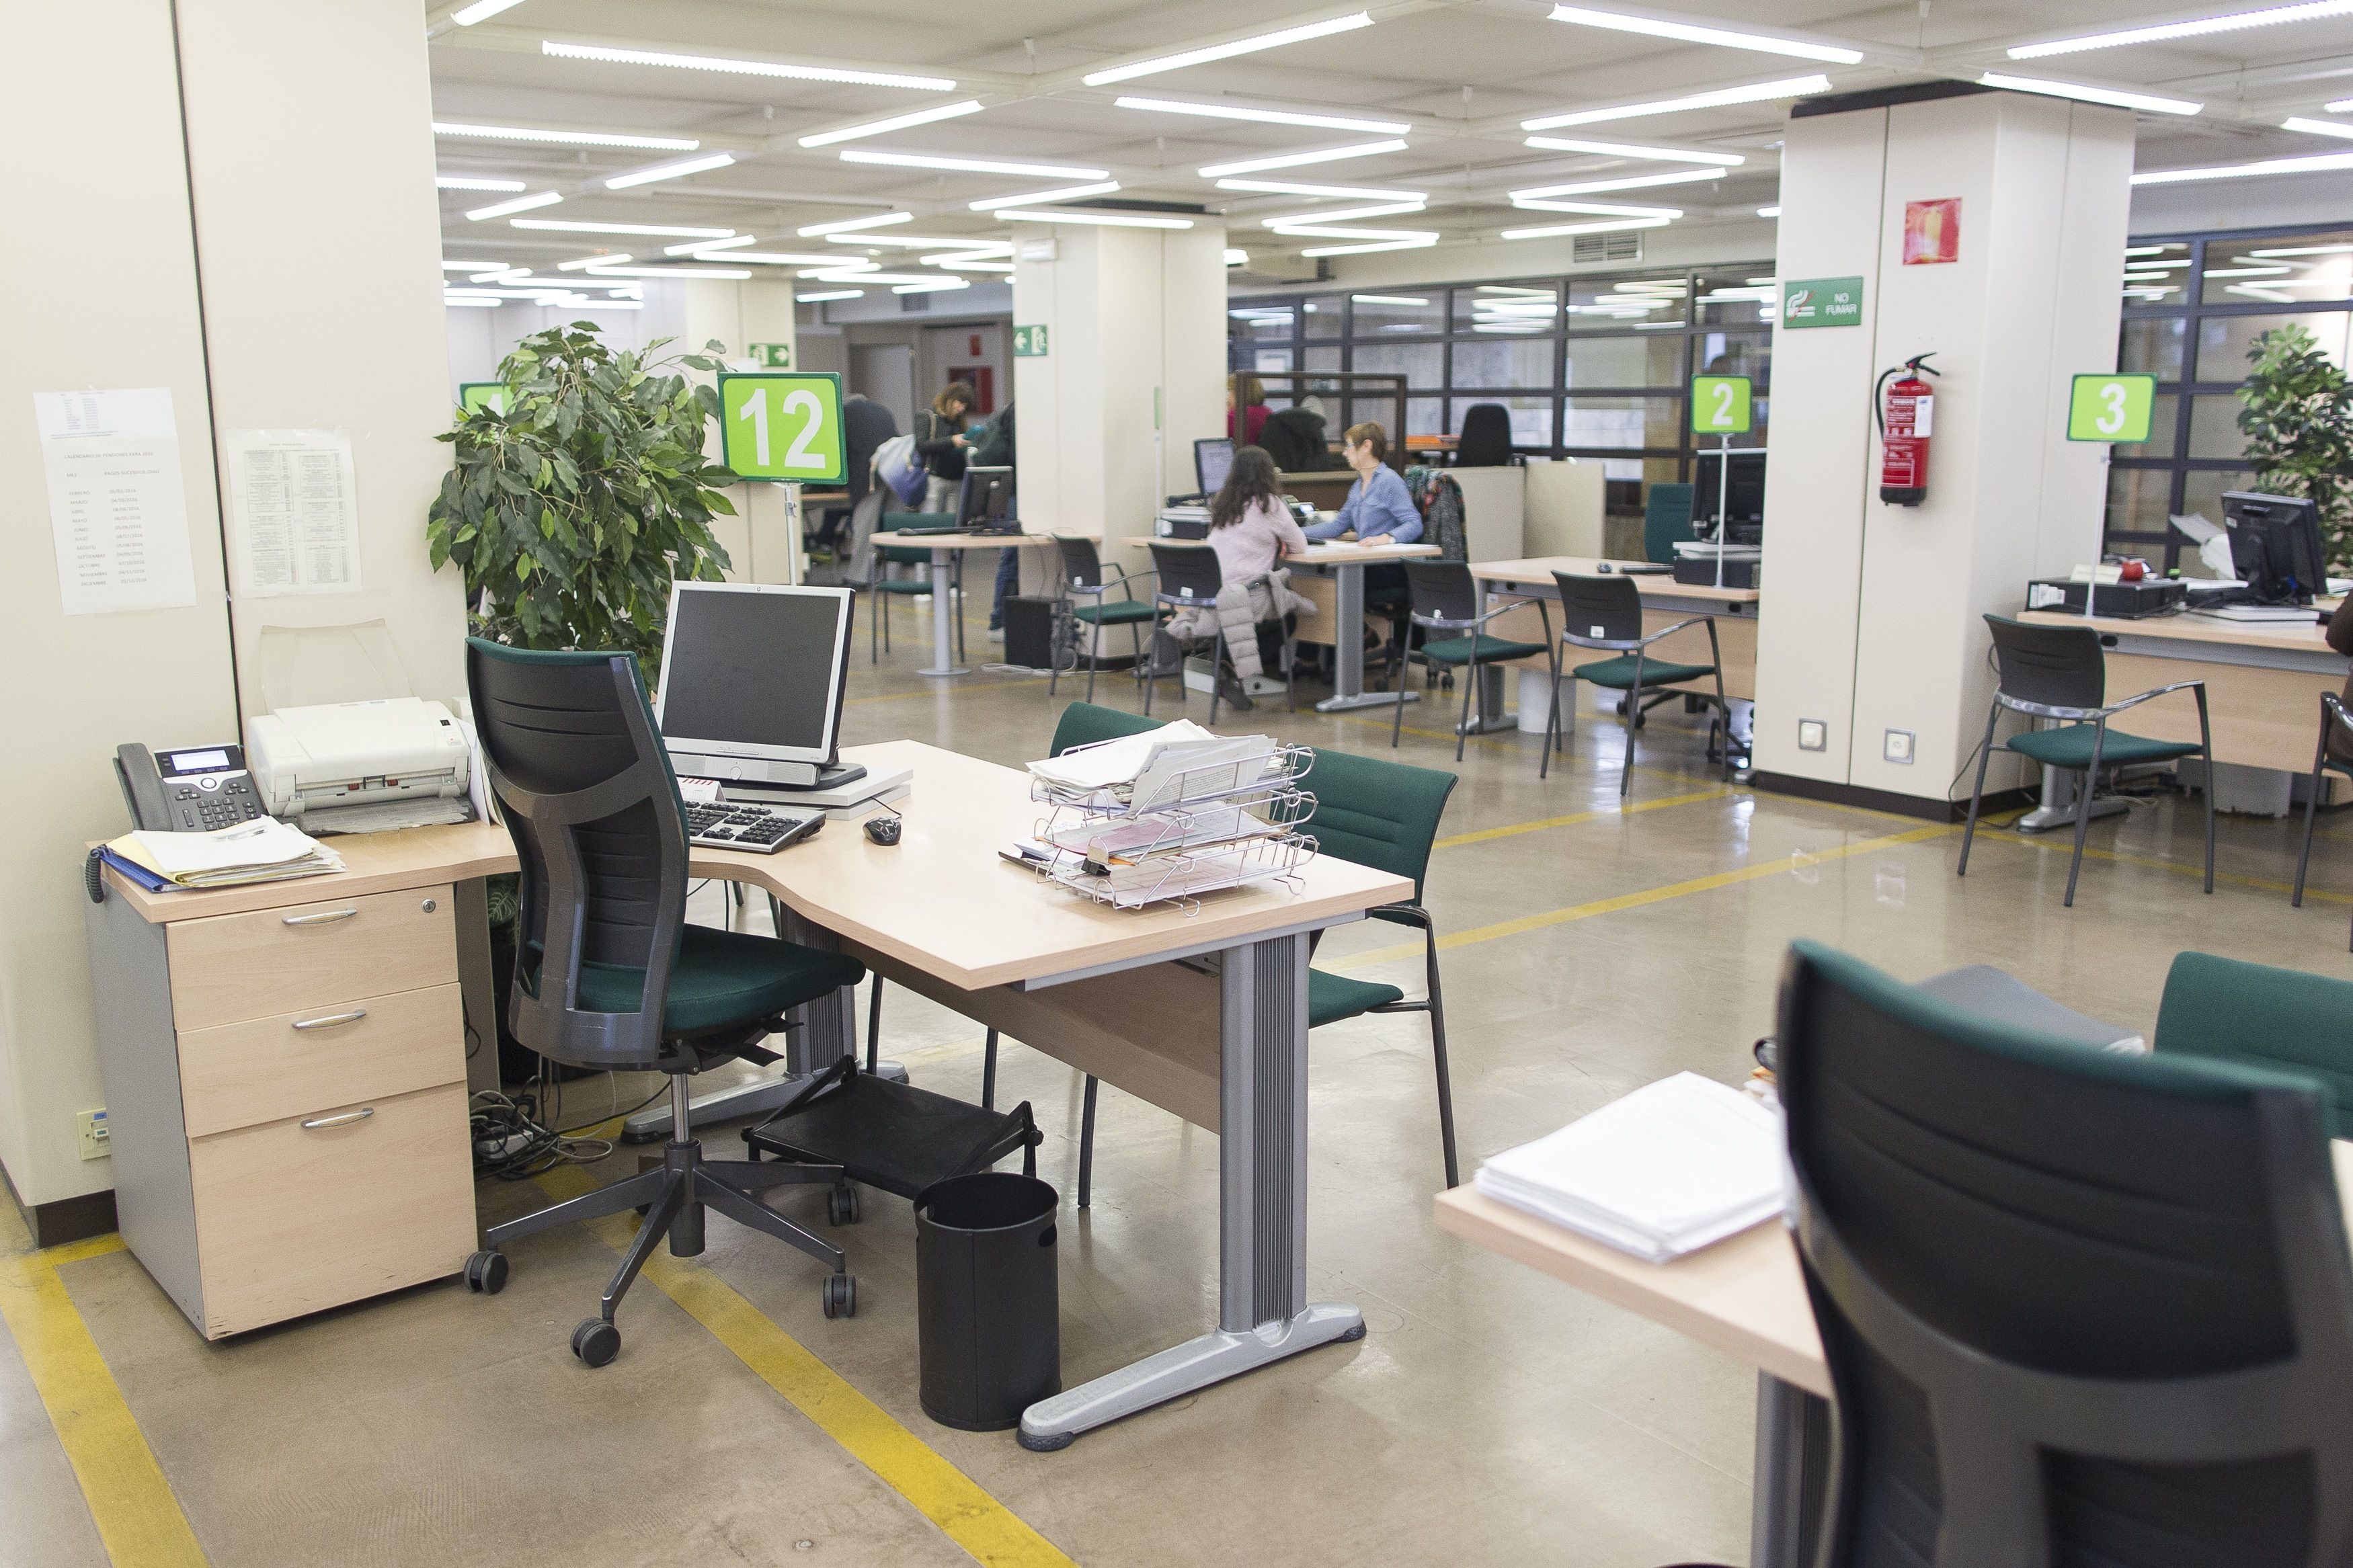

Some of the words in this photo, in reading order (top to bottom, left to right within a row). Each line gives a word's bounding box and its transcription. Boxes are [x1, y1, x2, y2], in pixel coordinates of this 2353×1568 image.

[1825, 304, 1858, 316] FUMAR
[1834, 292, 1850, 304] NO
[1712, 382, 1734, 426] 2
[2096, 383, 2126, 434] 3
[739, 388, 826, 470] 12
